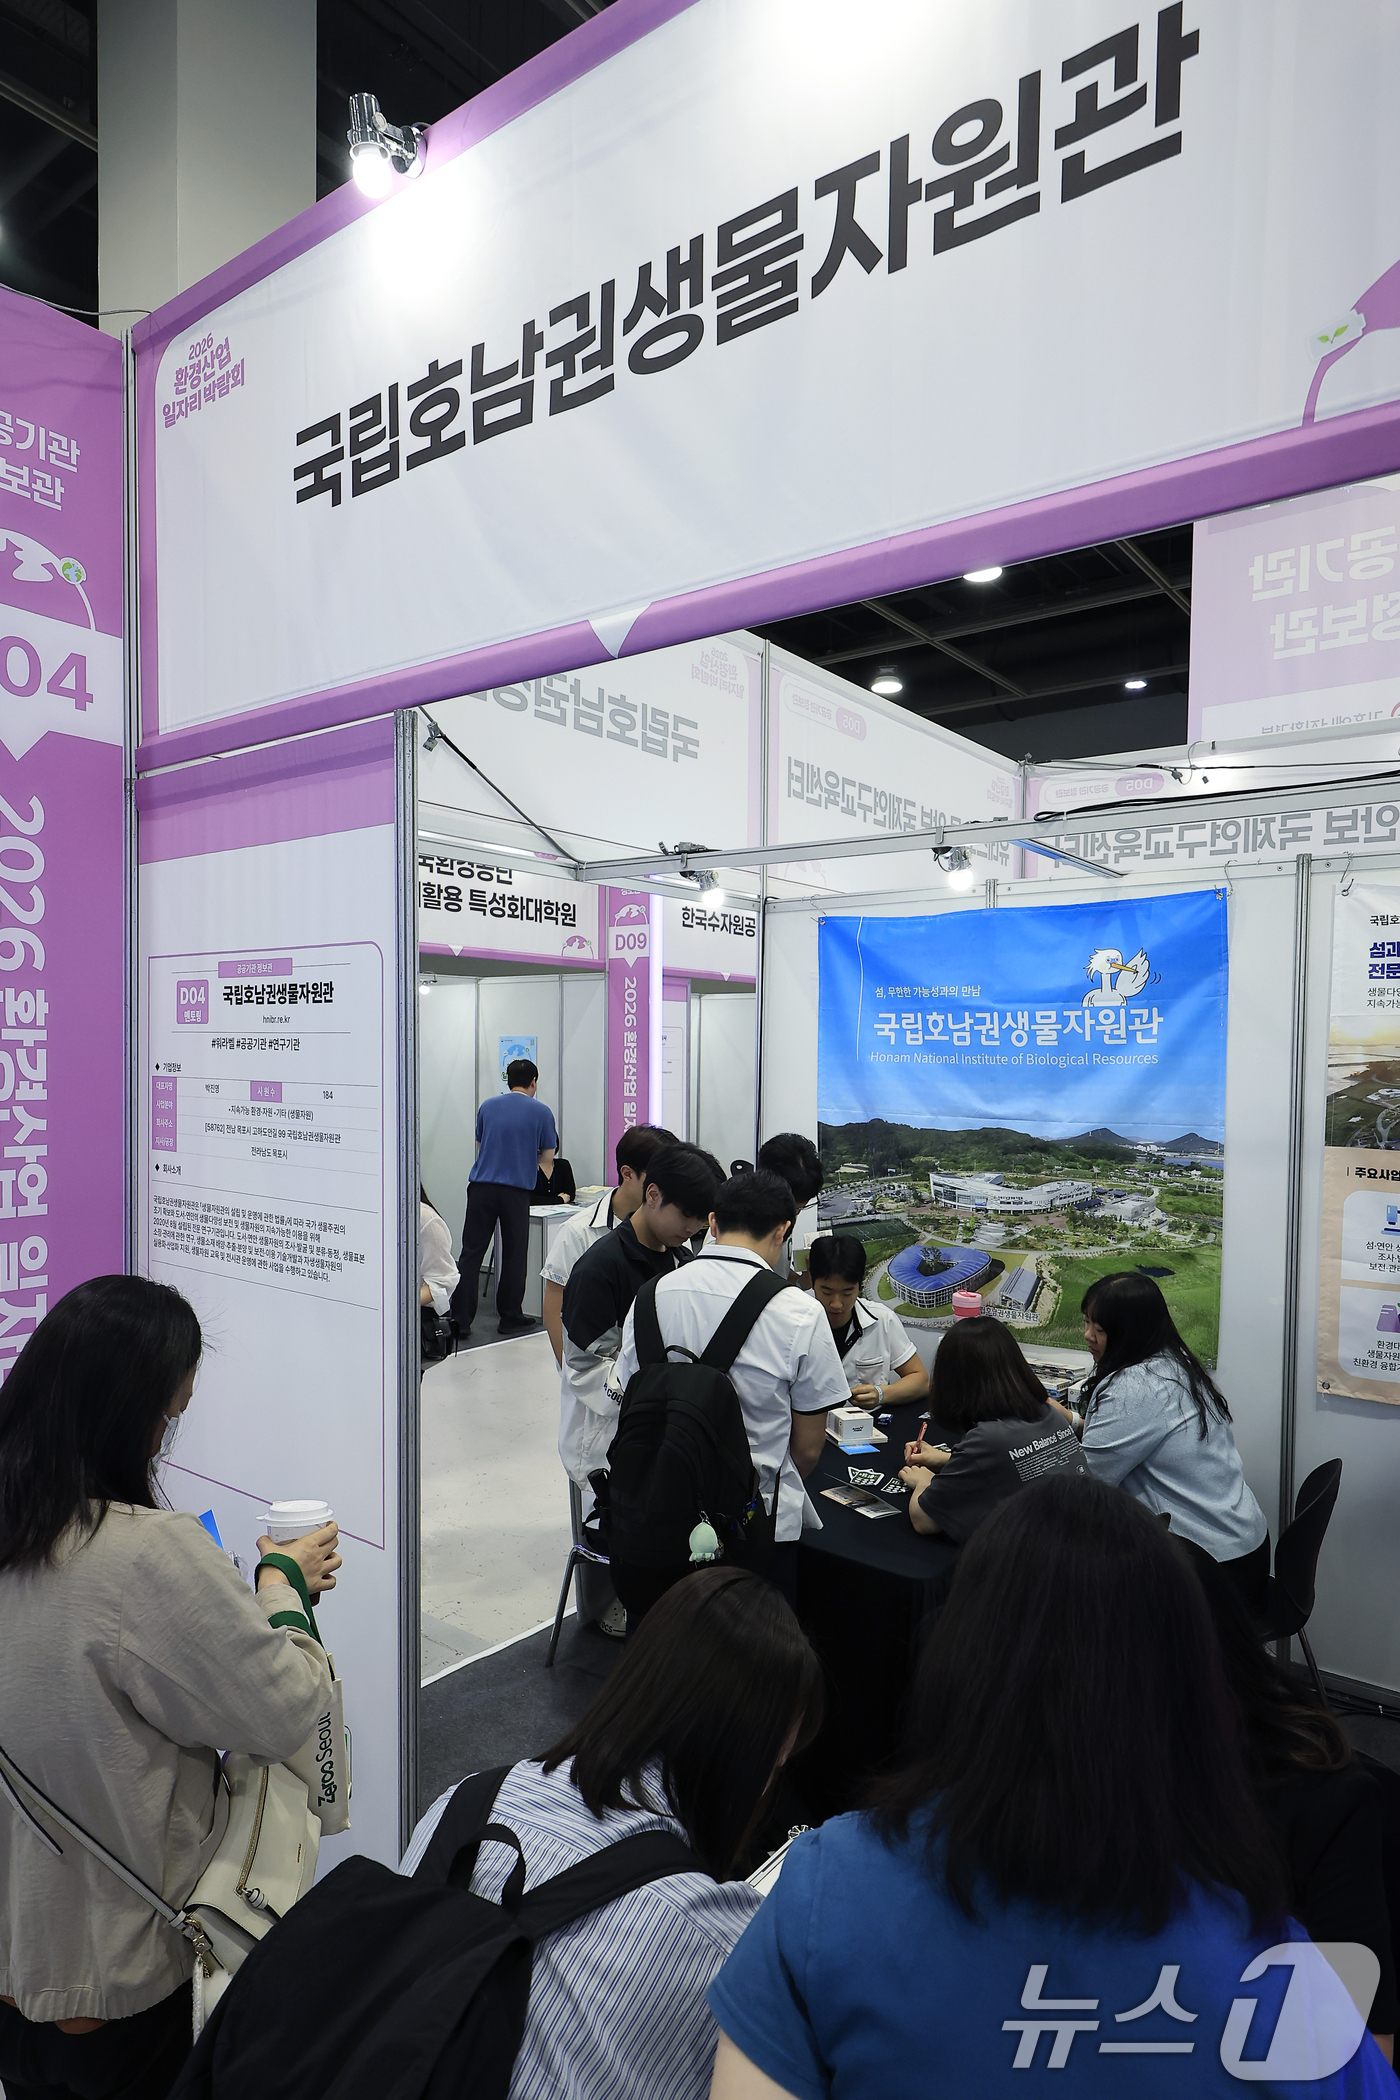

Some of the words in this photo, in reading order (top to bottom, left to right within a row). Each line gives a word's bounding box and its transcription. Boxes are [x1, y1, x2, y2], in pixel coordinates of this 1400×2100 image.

[294, 1, 1200, 508] 국립호남권생물자원관
[189, 332, 214, 361] 2026
[174, 336, 231, 396] 환경산업
[163, 389, 202, 429] 일자리
[204, 357, 245, 404] 박람회
[0, 634, 94, 712] 04
[0, 795, 47, 972] 2026
[419, 881, 463, 912] 활용
[469, 888, 577, 927] 특성화대학원
[682, 906, 757, 938] 한국수자원공
[615, 932, 647, 951] D09
[236, 963, 256, 975] 공공기관
[257, 962, 273, 974] 정보관
[1368, 963, 1400, 980] 전문
[180, 986, 206, 1005] D04
[222, 981, 335, 1006] 국립호남권생물자원관
[624, 976, 637, 1027] 2026
[875, 986, 886, 1000] 섬,
[888, 987, 911, 998] 무한한
[913, 986, 958, 998] 가능성과의
[961, 985, 981, 998] 만남
[184, 1009, 202, 1023] 멘토링
[262, 1015, 291, 1024] hnibr.re.kr
[873, 1006, 1164, 1048] 국립호남권생물자원관
[236, 1037, 268, 1051] #공공기관
[268, 1037, 301, 1052] #연구기관
[162, 1062, 182, 1073] 기업정보
[624, 1031, 638, 1097] 환경산업
[870, 1051, 911, 1063] Honam
[913, 1051, 959, 1065] National
[961, 1052, 1008, 1065] Institute
[1011, 1051, 1024, 1065] of
[1026, 1051, 1089, 1068] Biological
[1093, 1052, 1158, 1065] Resources
[322, 1090, 333, 1100] 184
[287, 1109, 314, 1122] (생물자원)
[204, 1122, 225, 1135] [58762]
[226, 1124, 236, 1134] 전남
[277, 1129, 286, 1138] 99
[287, 1129, 341, 1144] 국립호남권생물자원관
[250, 1146, 271, 1158] 전라남도
[272, 1148, 288, 1160] 목포시
[162, 1163, 182, 1176] 회사소개
[1355, 1166, 1400, 1181] 주요사업
[240, 1221, 265, 1234] 생물자원의
[266, 1225, 291, 1239] 지속가능한
[309, 1232, 321, 1244] 위해
[293, 1217, 304, 1228] 따라
[305, 1219, 317, 1230] 국가
[317, 1221, 346, 1235] 생물주권의
[258, 1236, 284, 1249] 생물자원의
[342, 1250, 366, 1264] 생물표본
[268, 1261, 284, 1274] 사업을
[285, 1264, 307, 1277] 수행하고
[1353, 1357, 1378, 1369] 친환경
[1008, 1444, 1033, 1460] New
[1056, 1427, 1072, 1440] Since
[316, 1711, 333, 1762] Seoul
